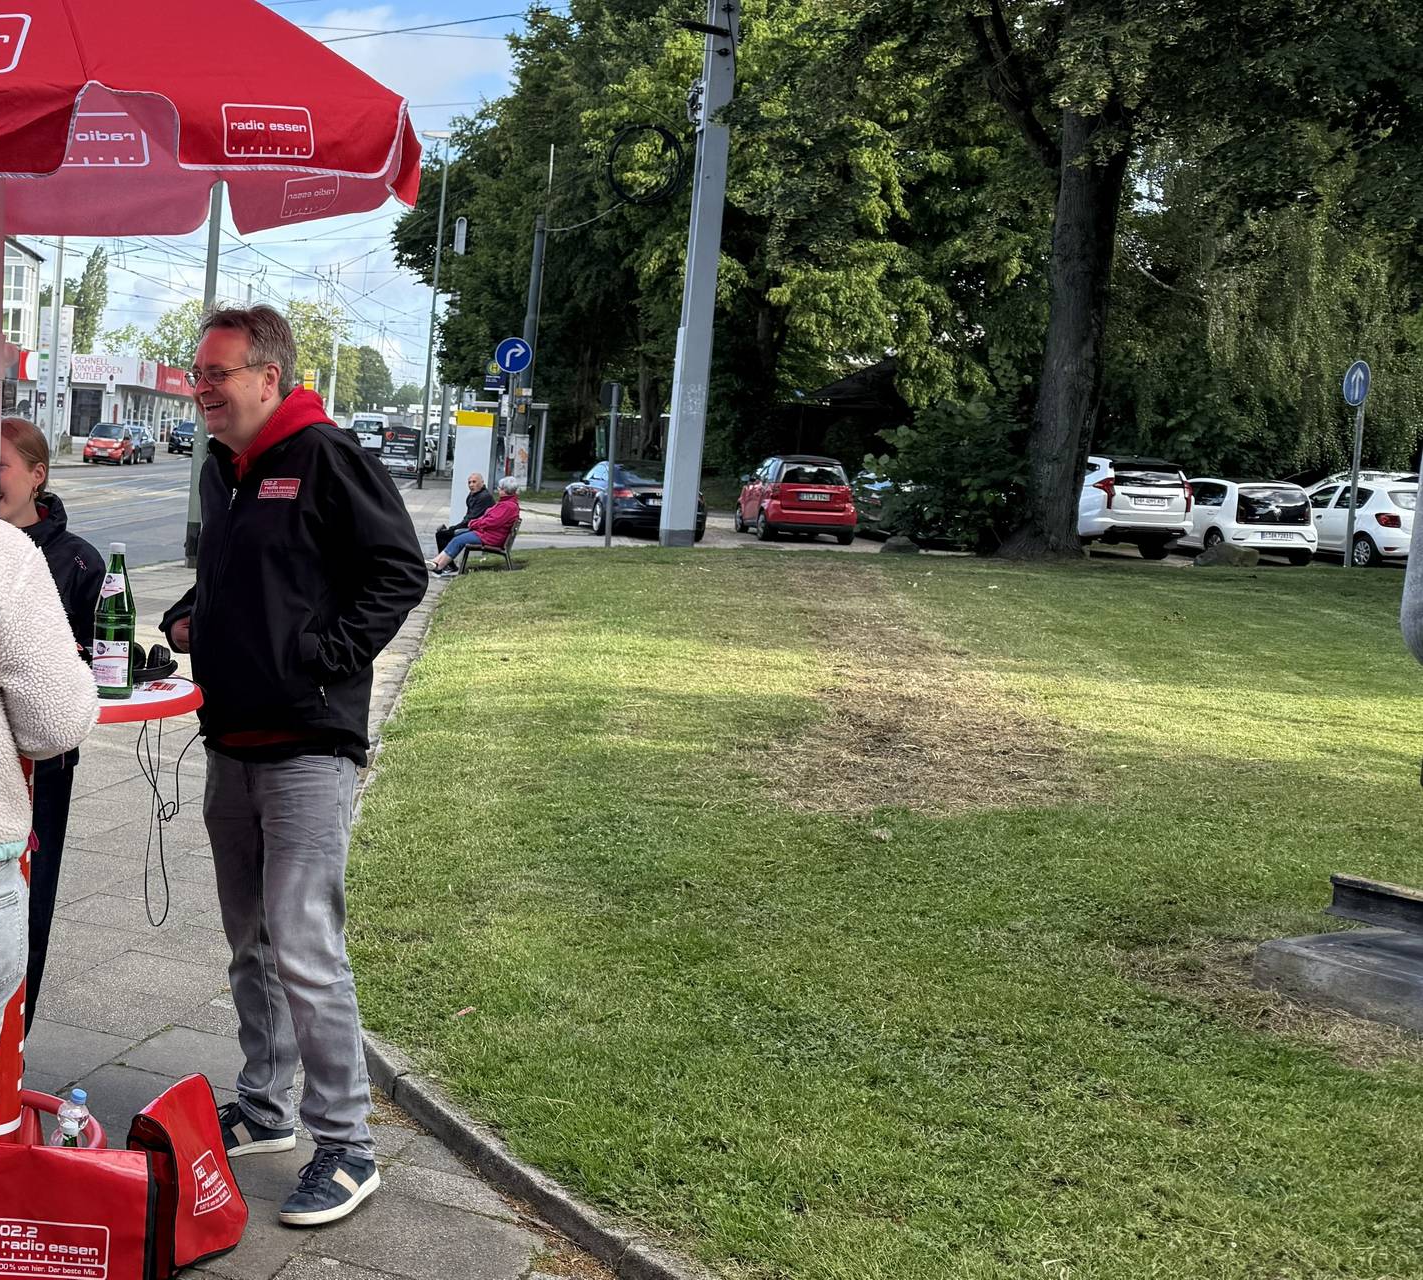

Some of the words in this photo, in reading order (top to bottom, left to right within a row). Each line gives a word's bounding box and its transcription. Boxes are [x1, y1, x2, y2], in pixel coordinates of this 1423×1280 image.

[230, 120, 265, 130] radio
[269, 123, 307, 133] essen
[74, 356, 110, 366] SCHNELL
[74, 364, 123, 374] VINYLBODEN
[73, 372, 103, 381] OUTLET
[1, 1239, 45, 1251] radio
[48, 1243, 98, 1256] essen
[31, 1264, 46, 1272] hier.
[48, 1266, 62, 1274] Der
[62, 1267, 82, 1275] beste
[83, 1268, 98, 1276] Mix.
